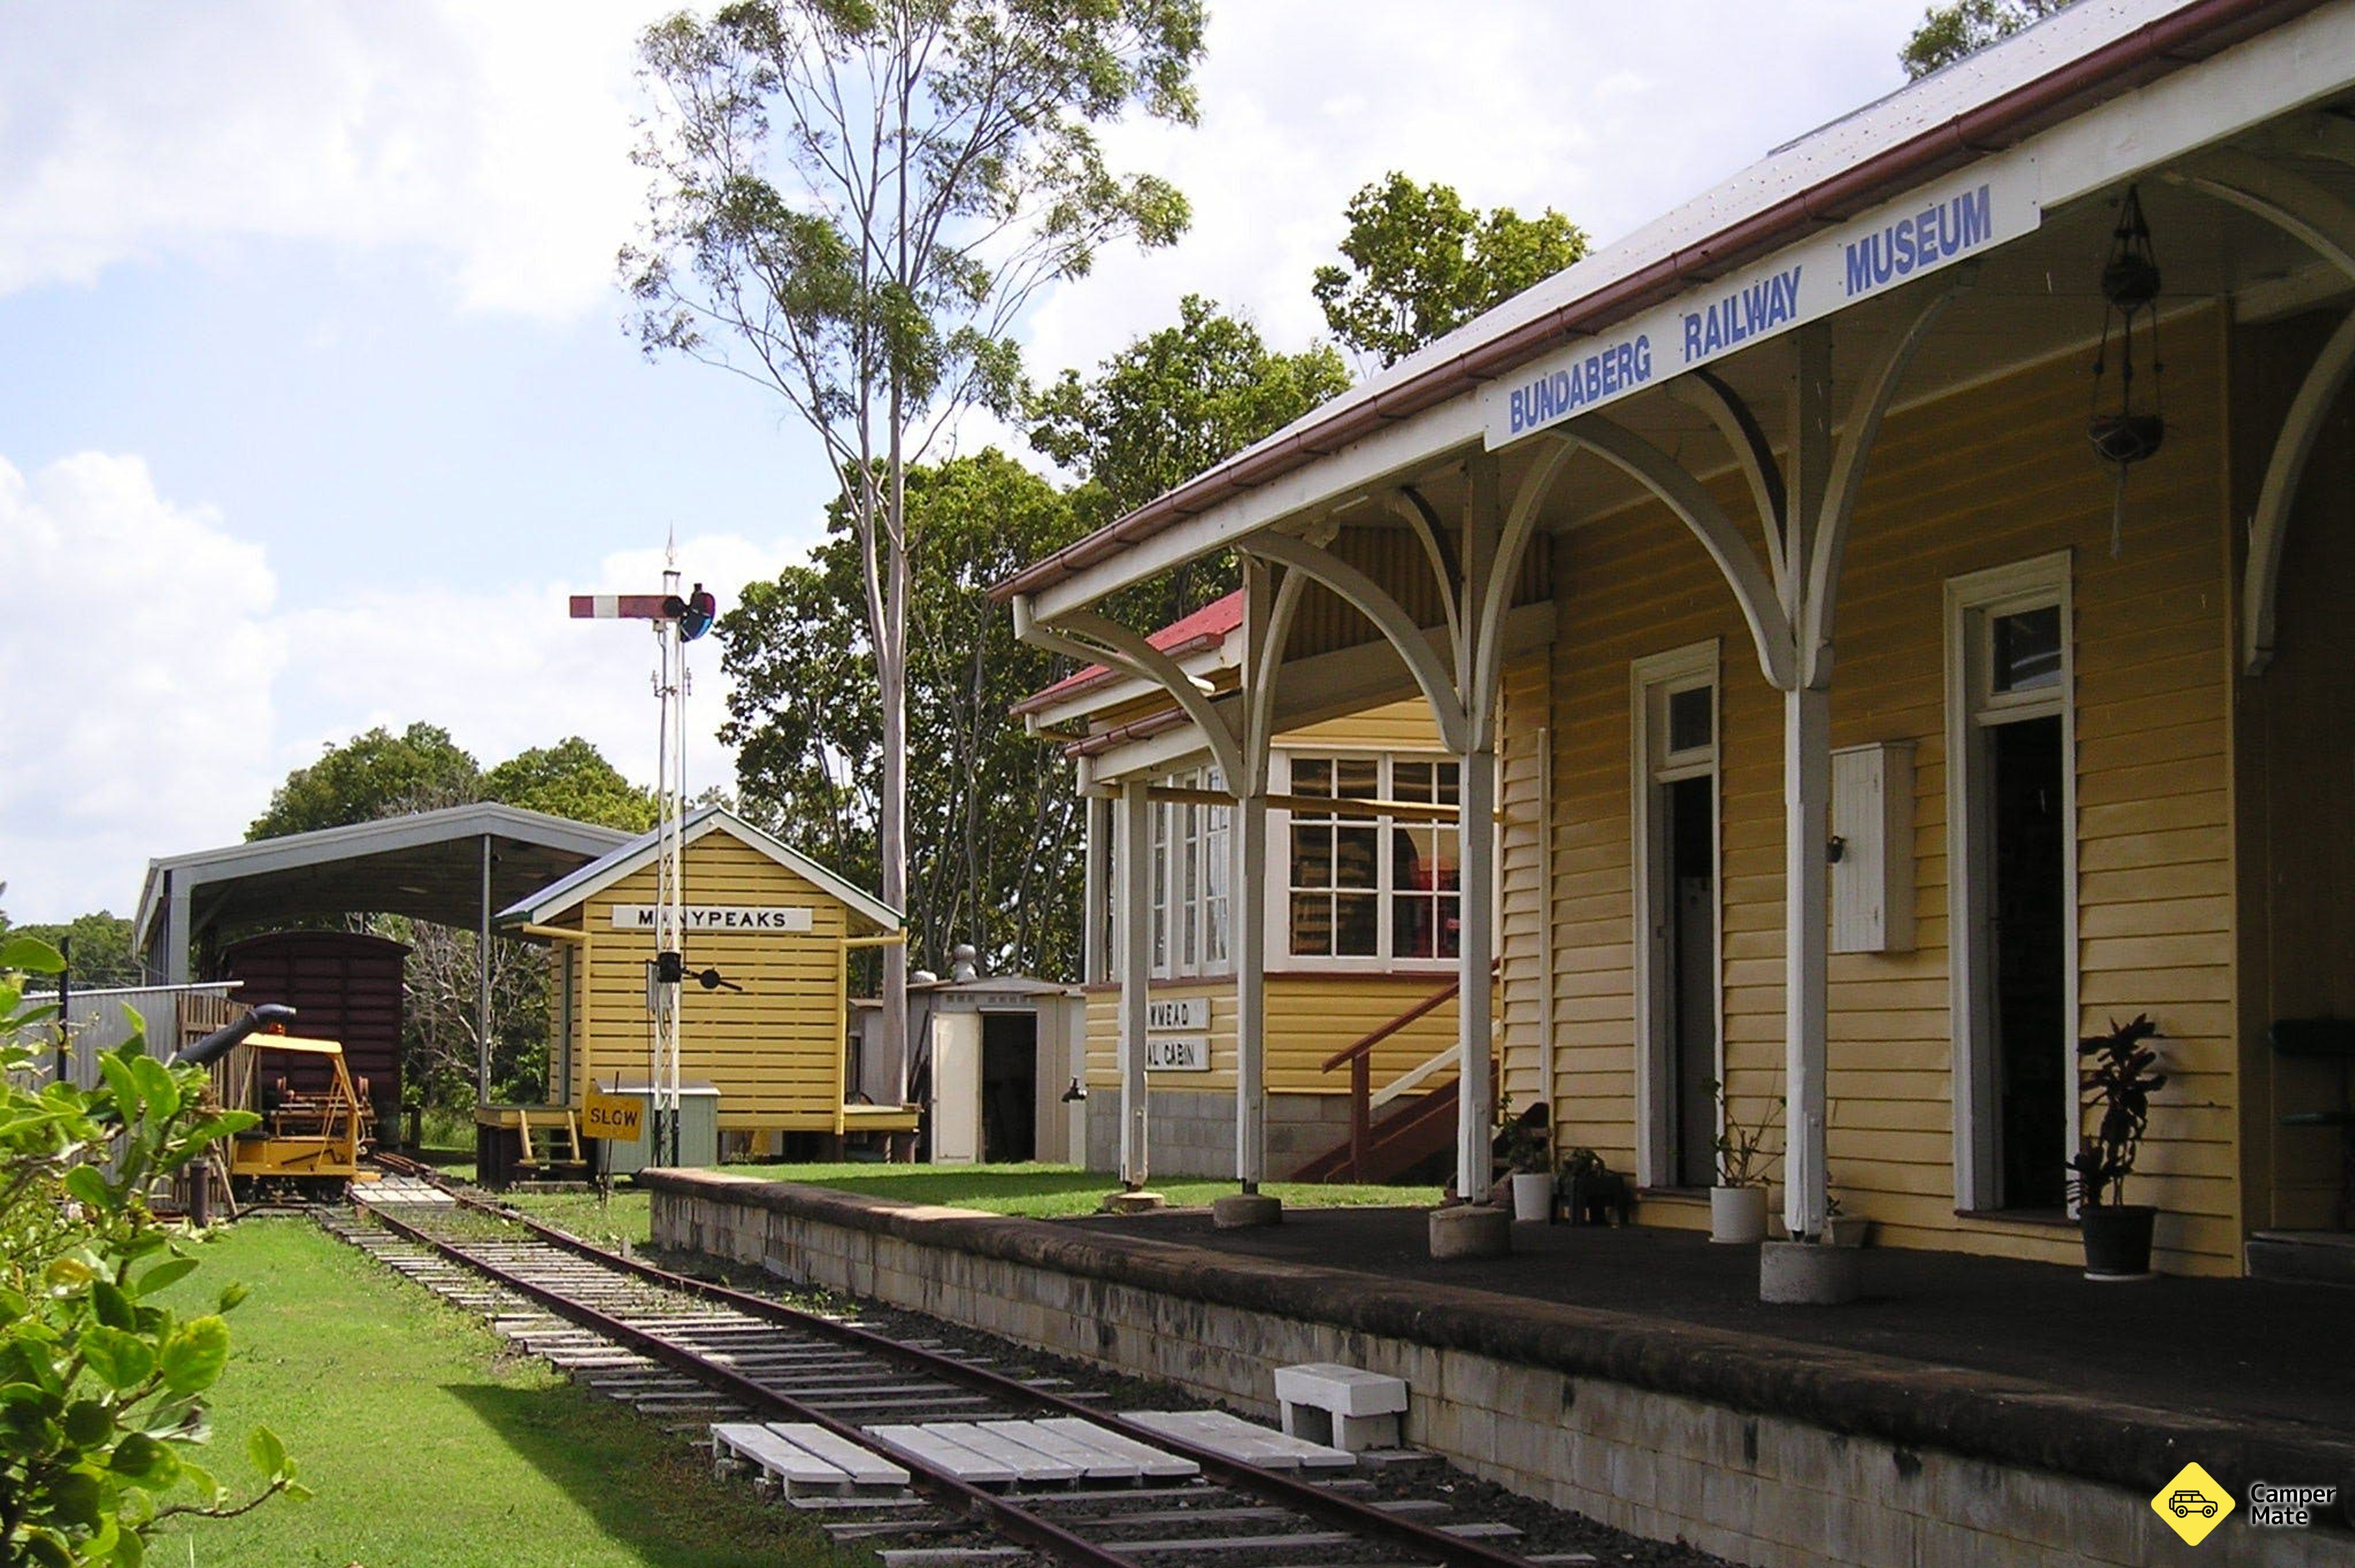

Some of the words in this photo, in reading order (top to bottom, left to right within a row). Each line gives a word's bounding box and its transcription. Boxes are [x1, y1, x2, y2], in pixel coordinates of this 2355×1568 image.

[1510, 334, 1650, 434] BUNDABERG
[1684, 265, 1803, 363] RAILWAY
[1845, 184, 1992, 297] MUSEUM
[590, 1107, 638, 1127] SLOW
